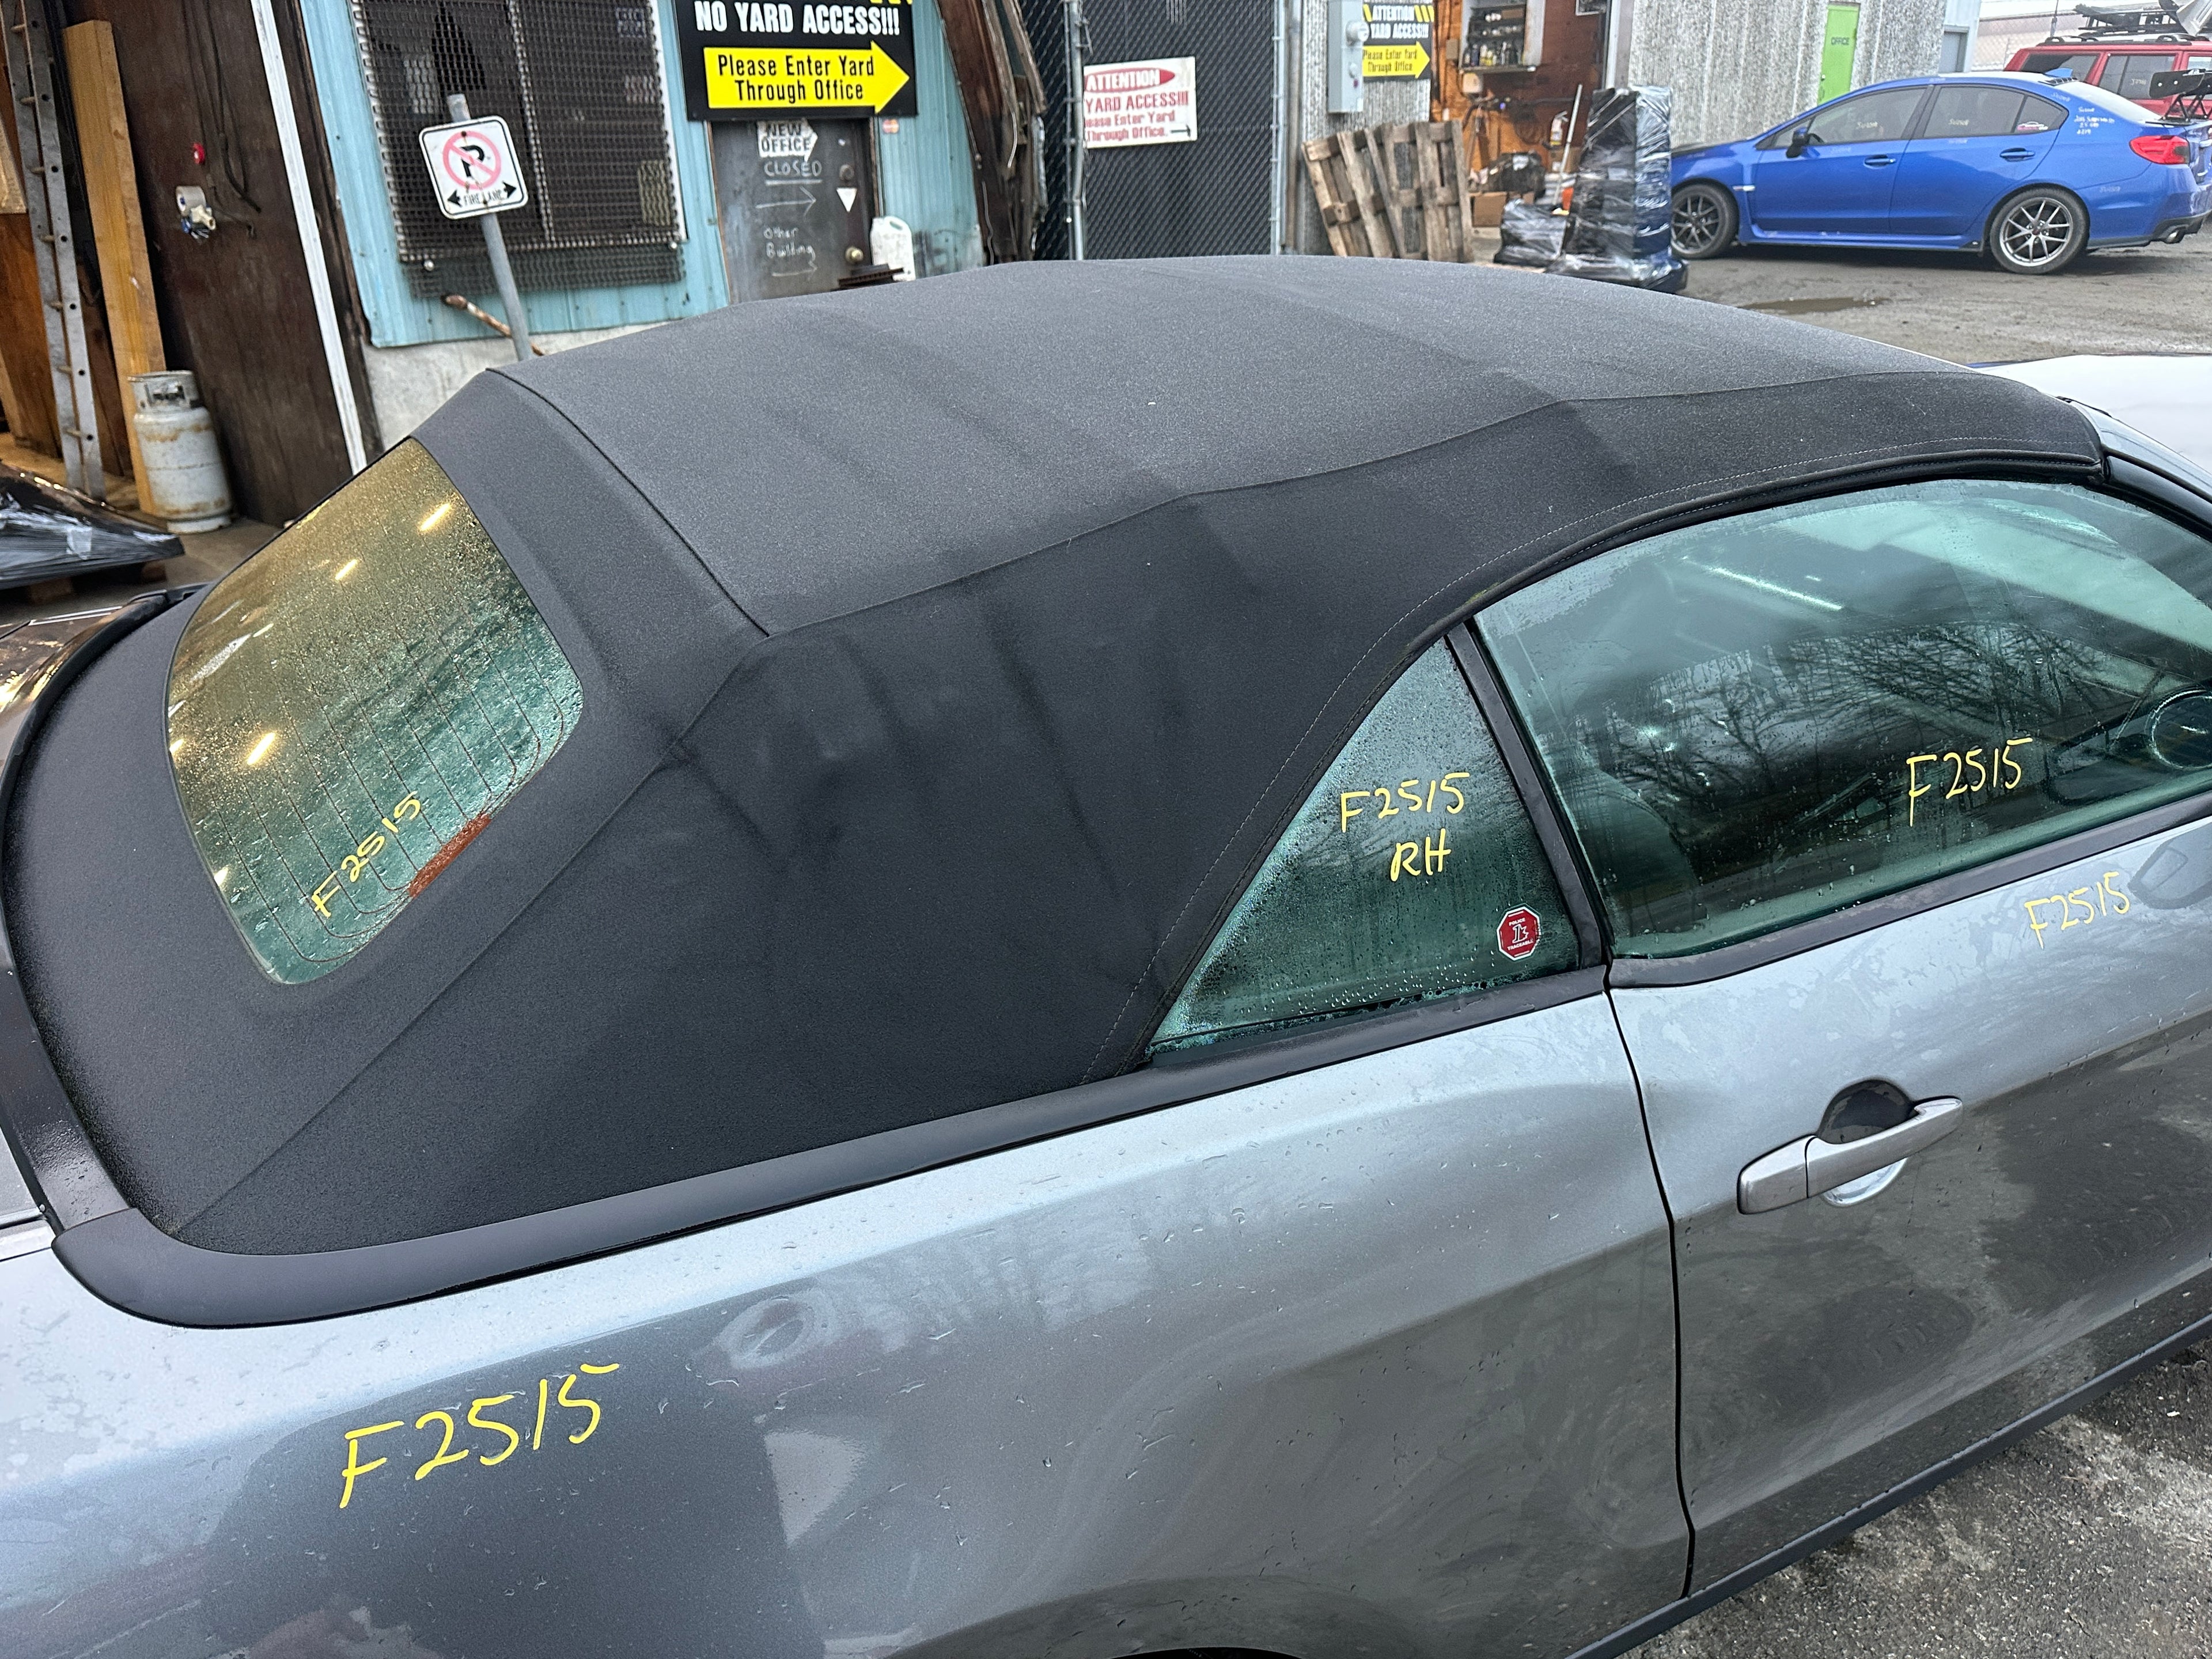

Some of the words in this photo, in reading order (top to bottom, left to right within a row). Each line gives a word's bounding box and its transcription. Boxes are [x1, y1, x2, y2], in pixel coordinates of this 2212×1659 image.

[694, 1, 727, 32] NO
[734, 2, 793, 33] YARD
[802, 5, 900, 35] ACCESS!!!
[718, 54, 777, 76] Please
[786, 55, 830, 75] Enter
[839, 55, 874, 75] Yard
[1086, 69, 1160, 90] ATTENTION
[735, 79, 806, 104] Through
[815, 80, 863, 100] Office
[1085, 97, 1121, 113] YARD
[1114, 114, 1145, 126] Enter
[1148, 110, 1175, 123] Yard
[767, 122, 801, 136] NEW
[1087, 128, 1128, 141] Through
[761, 137, 810, 152] OFFICE
[764, 160, 822, 177] CLOSED
[1906, 737, 2033, 827] F2515
[1340, 771, 1470, 833] F2515
[312, 790, 421, 918] F2515
[1391, 828, 1451, 882] RH
[2024, 872, 2130, 949] F2515
[1509, 918, 1525, 926] POLICE
[1507, 940, 1533, 950] TRACEABLE
[339, 1362, 620, 1509] F2515
